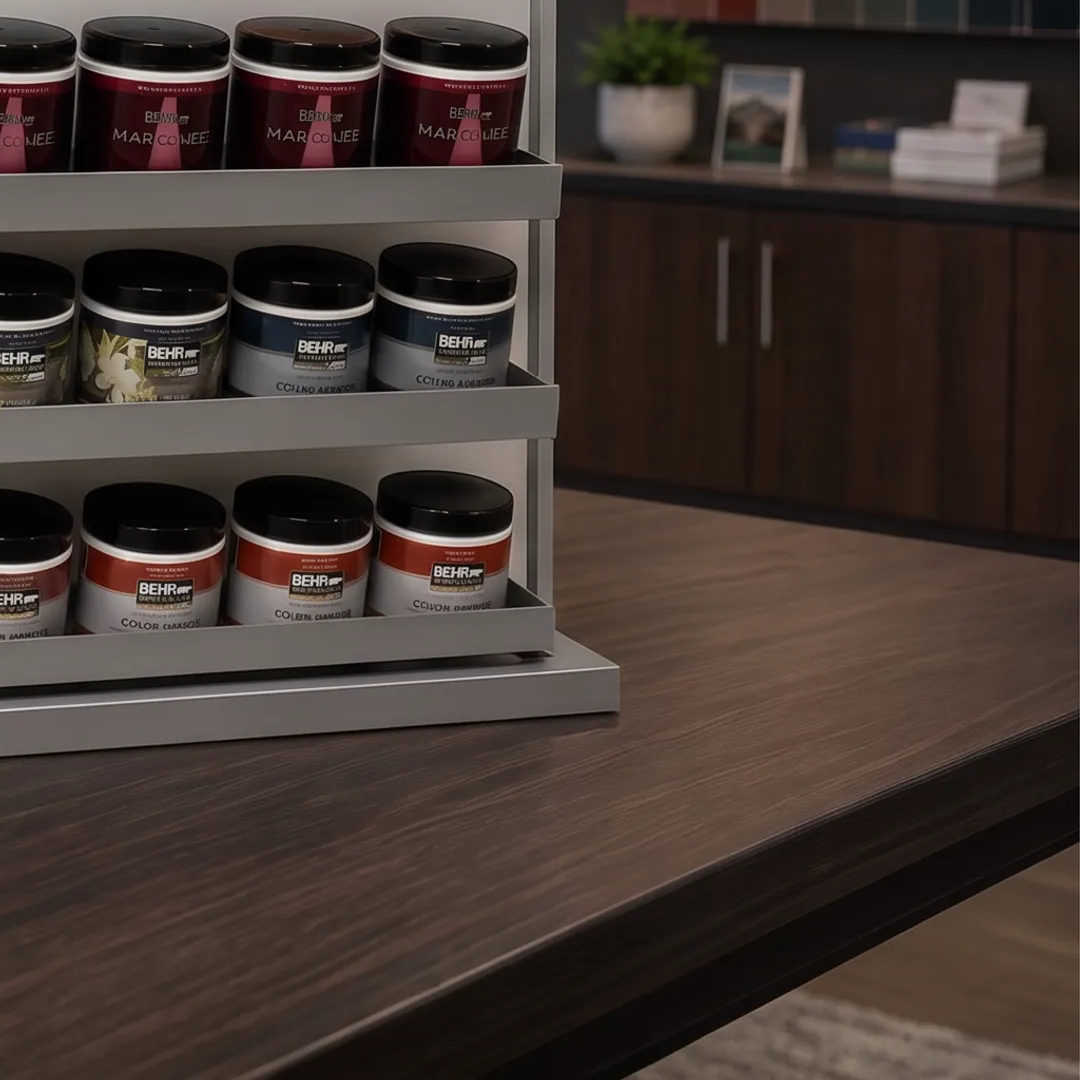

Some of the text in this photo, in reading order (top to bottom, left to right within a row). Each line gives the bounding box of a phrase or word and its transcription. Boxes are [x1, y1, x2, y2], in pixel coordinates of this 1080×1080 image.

[148, 346, 184, 360] BEHR
[298, 340, 334, 355] BEHR
[433, 565, 469, 578] BEHR
[292, 574, 328, 587] BEHR
[139, 582, 177, 595] BEHR
